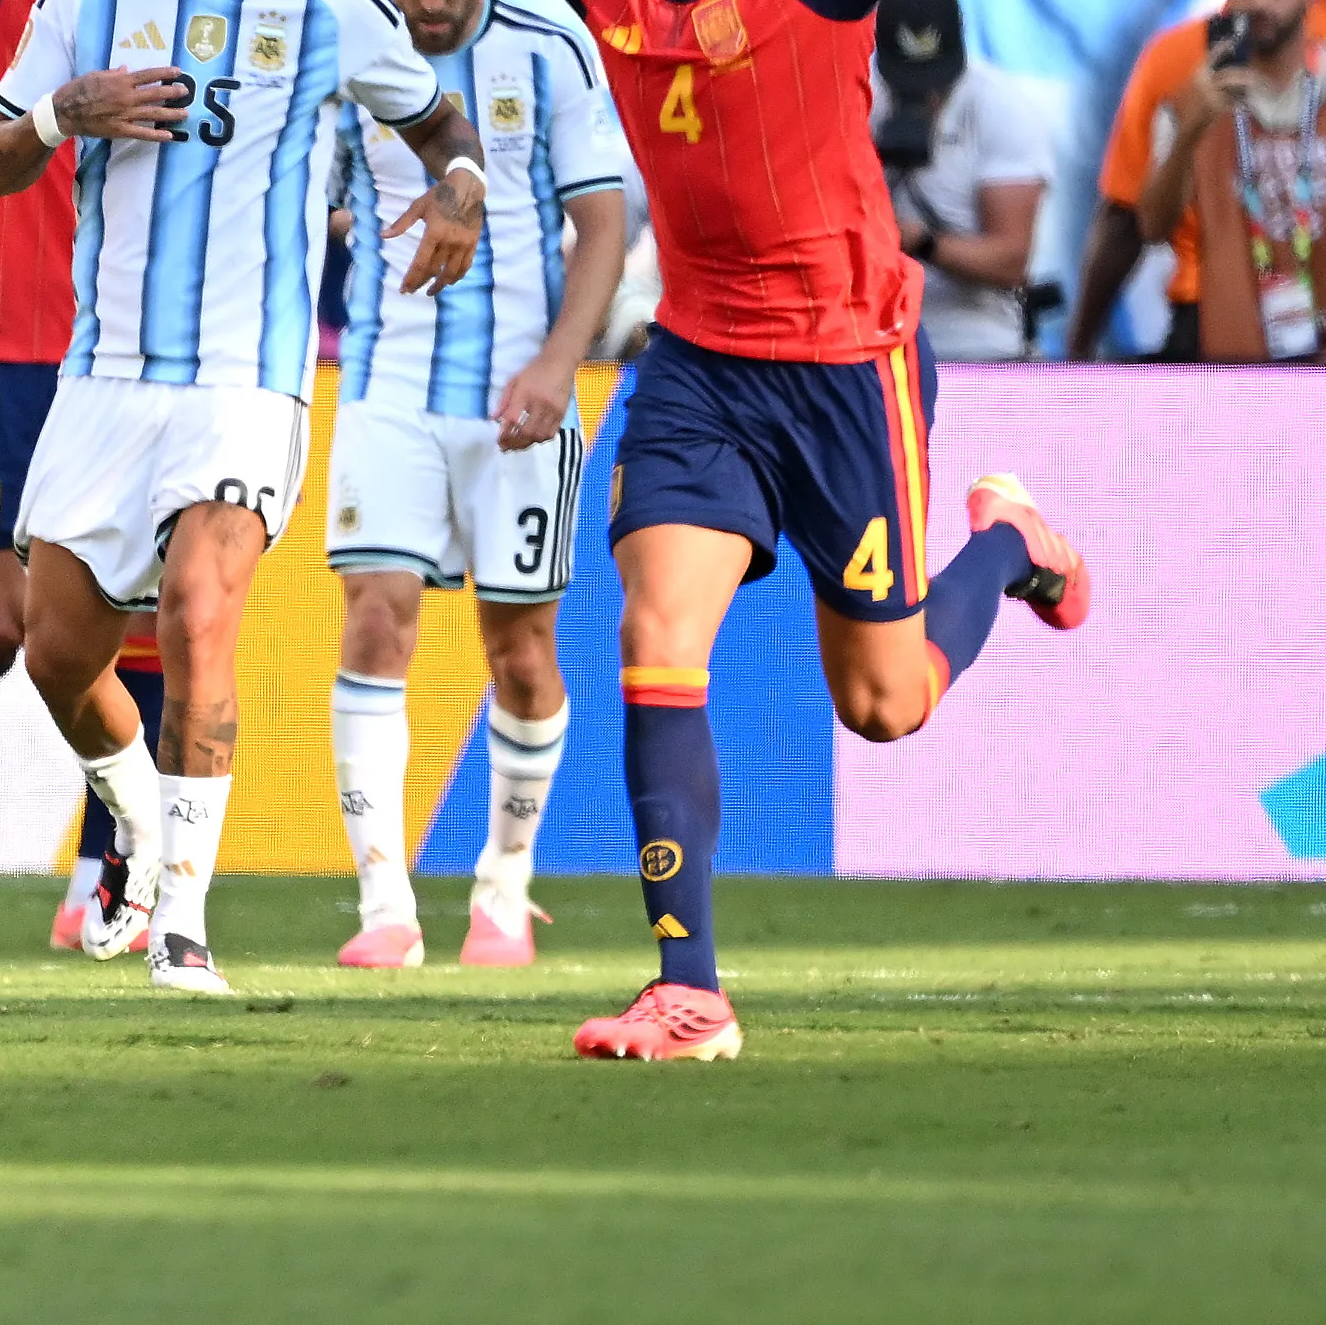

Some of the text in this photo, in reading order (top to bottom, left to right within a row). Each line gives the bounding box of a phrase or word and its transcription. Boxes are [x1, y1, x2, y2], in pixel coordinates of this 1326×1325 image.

[659, 64, 702, 144] 4
[514, 506, 548, 574] 3
[843, 517, 895, 602] 4
